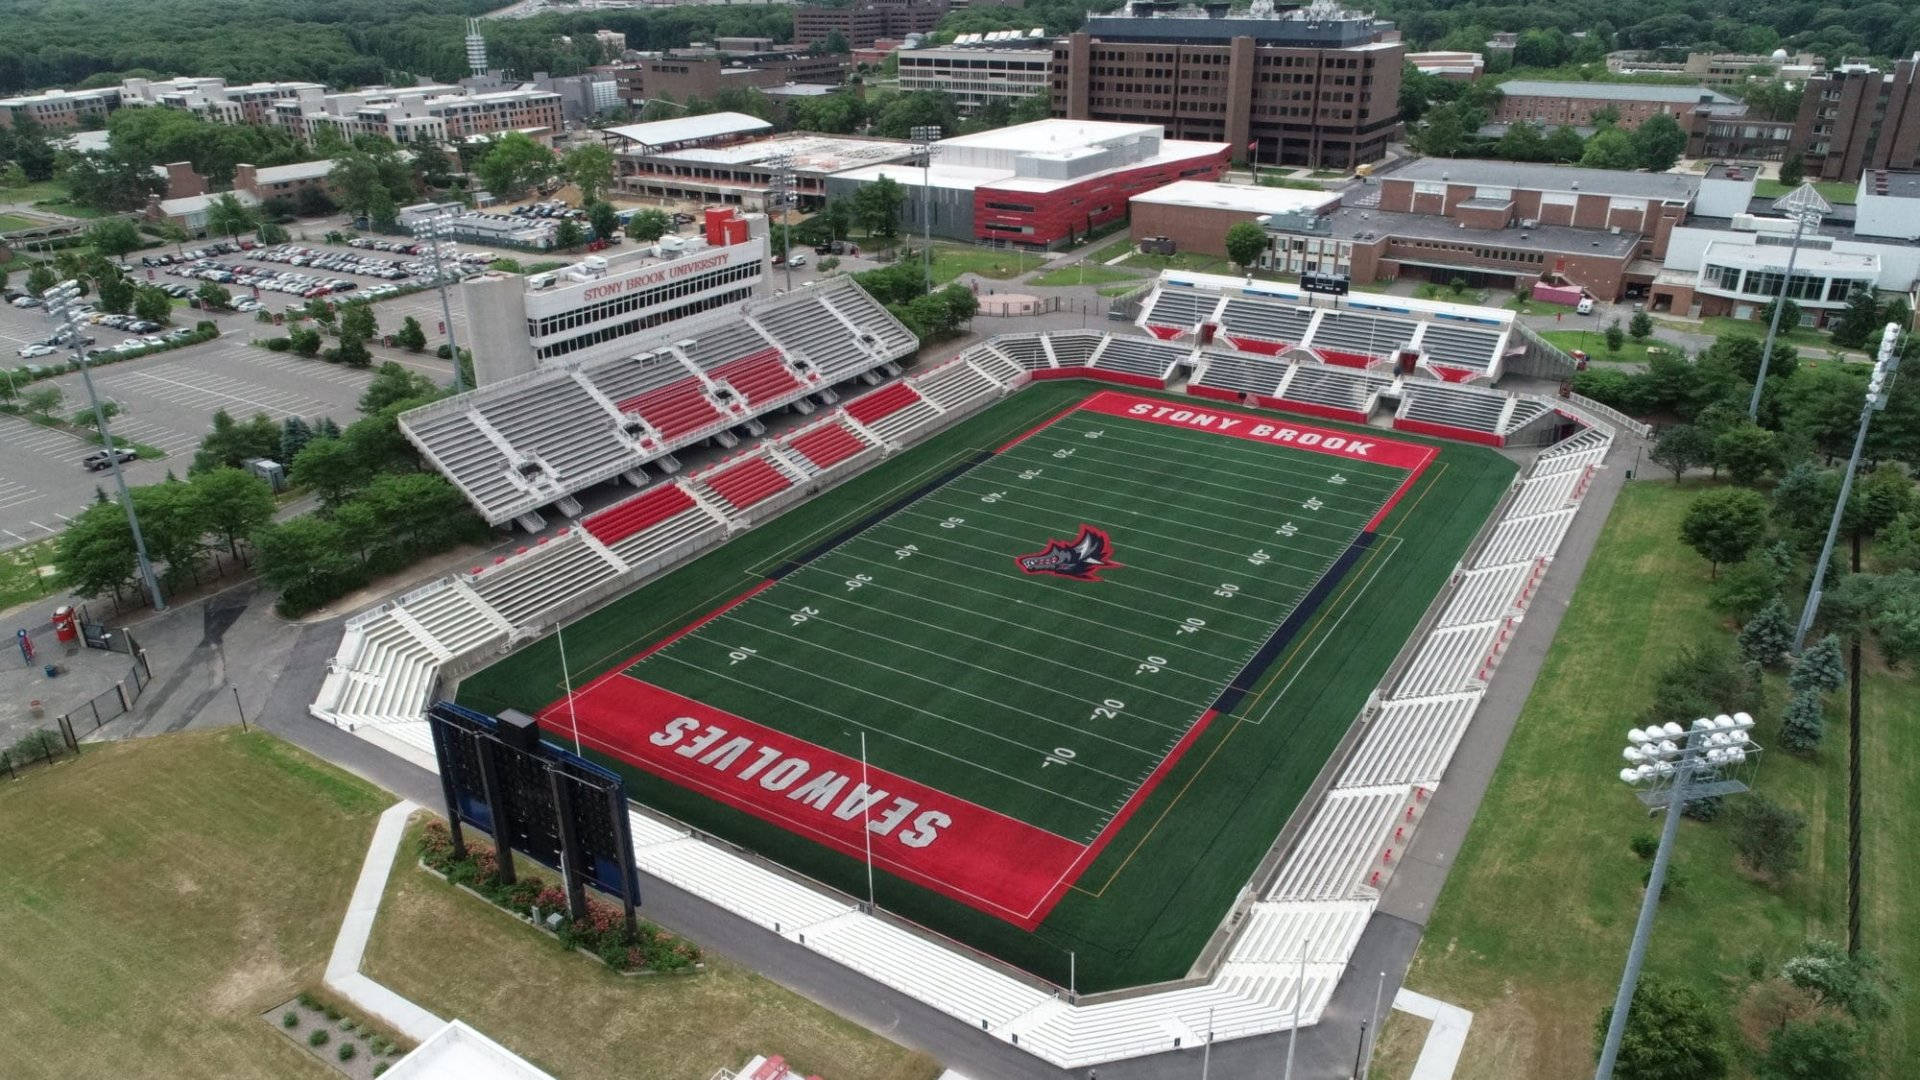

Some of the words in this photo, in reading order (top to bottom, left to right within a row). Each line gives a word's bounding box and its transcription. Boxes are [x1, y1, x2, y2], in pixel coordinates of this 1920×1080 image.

[583, 280, 623, 301] STONY
[625, 269, 666, 291] BROOK
[669, 252, 730, 279] UNIVERSITY
[1128, 403, 1242, 430] STONY
[1250, 423, 1376, 456] BROOK
[940, 516, 965, 529] 50
[1275, 524, 1299, 537] 30
[895, 544, 919, 557] 40
[845, 573, 873, 588] 30
[1213, 583, 1240, 598] 50
[790, 606, 820, 622] 20
[1180, 617, 1206, 633] 40
[729, 646, 758, 661] 10
[1139, 656, 1168, 673] 30
[1094, 699, 1125, 719] 20
[1045, 747, 1076, 765] 10
[649, 717, 952, 847] SEAWOLVES
